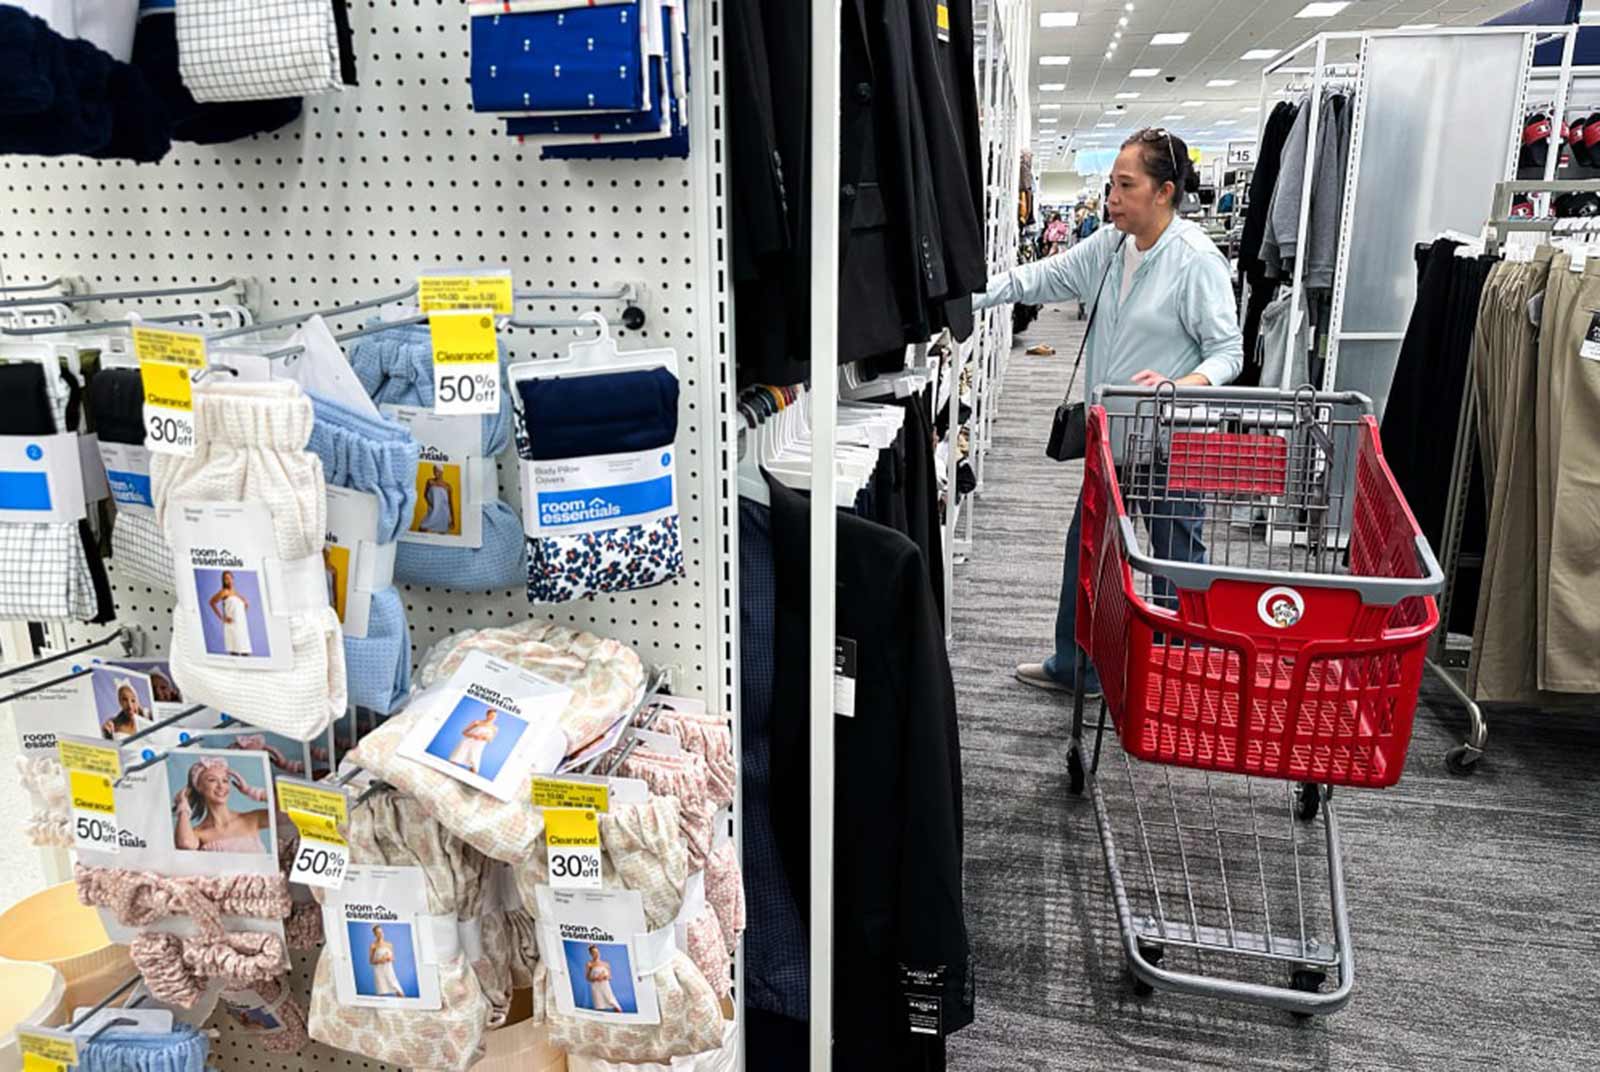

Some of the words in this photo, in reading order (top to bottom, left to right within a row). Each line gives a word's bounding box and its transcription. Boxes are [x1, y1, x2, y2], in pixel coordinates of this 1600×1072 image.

[475, 390, 495, 402] off
[177, 435, 192, 446] off
[419, 451, 449, 462] ntials
[541, 499, 585, 514] room
[541, 503, 621, 524] essentials
[190, 547, 218, 557] room
[192, 556, 244, 567] essentials
[469, 682, 501, 699] room
[466, 688, 522, 715] essentials
[23, 733, 56, 741] room
[102, 834, 117, 844] off
[118, 834, 147, 849] tials
[324, 866, 342, 878] off
[582, 867, 598, 878] off
[344, 903, 373, 912] room
[345, 910, 398, 921] essentials
[560, 923, 588, 933] room
[561, 931, 614, 942] essentials
